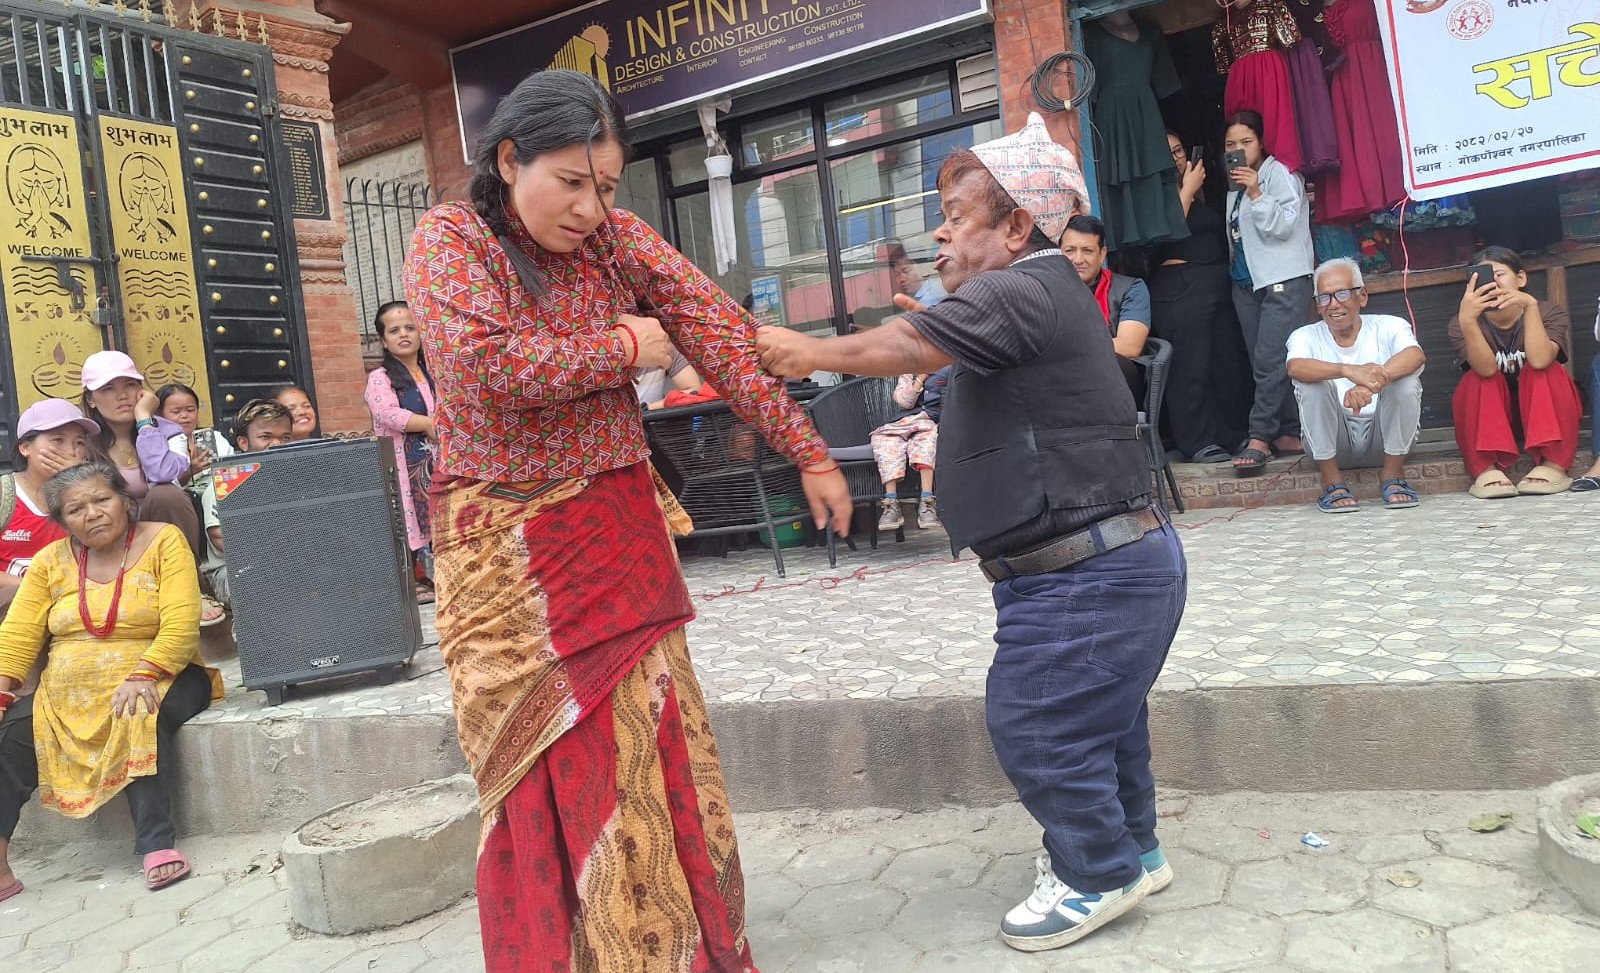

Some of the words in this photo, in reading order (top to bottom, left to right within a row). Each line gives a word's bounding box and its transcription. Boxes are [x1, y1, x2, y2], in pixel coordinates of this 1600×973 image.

[614, 50, 672, 81] DESIGN
[675, 46, 687, 62] &
[689, 2, 821, 57] CONSTRUCTION
[626, 0, 800, 58] INFINI
[616, 75, 665, 95] ARCHITECTURE
[686, 58, 719, 73] INTERIOR
[738, 36, 787, 57] ENGINEERING
[803, 11, 863, 36] CONSTRUCTION
[739, 53, 768, 68] CONTACT
[29, 121, 69, 139] लाभ
[106, 126, 136, 147] शुभ
[138, 131, 172, 148] लाभ
[1414, 143, 1438, 157] मिति
[1455, 125, 1534, 151] २०८२/०२/२७
[1416, 161, 1442, 174] स्थान
[1458, 147, 1515, 165] गोकर्णेश्वर
[1519, 132, 1587, 153] नगरपालिका
[8, 244, 83, 259] WELCOME
[121, 248, 187, 262] WELCOME
